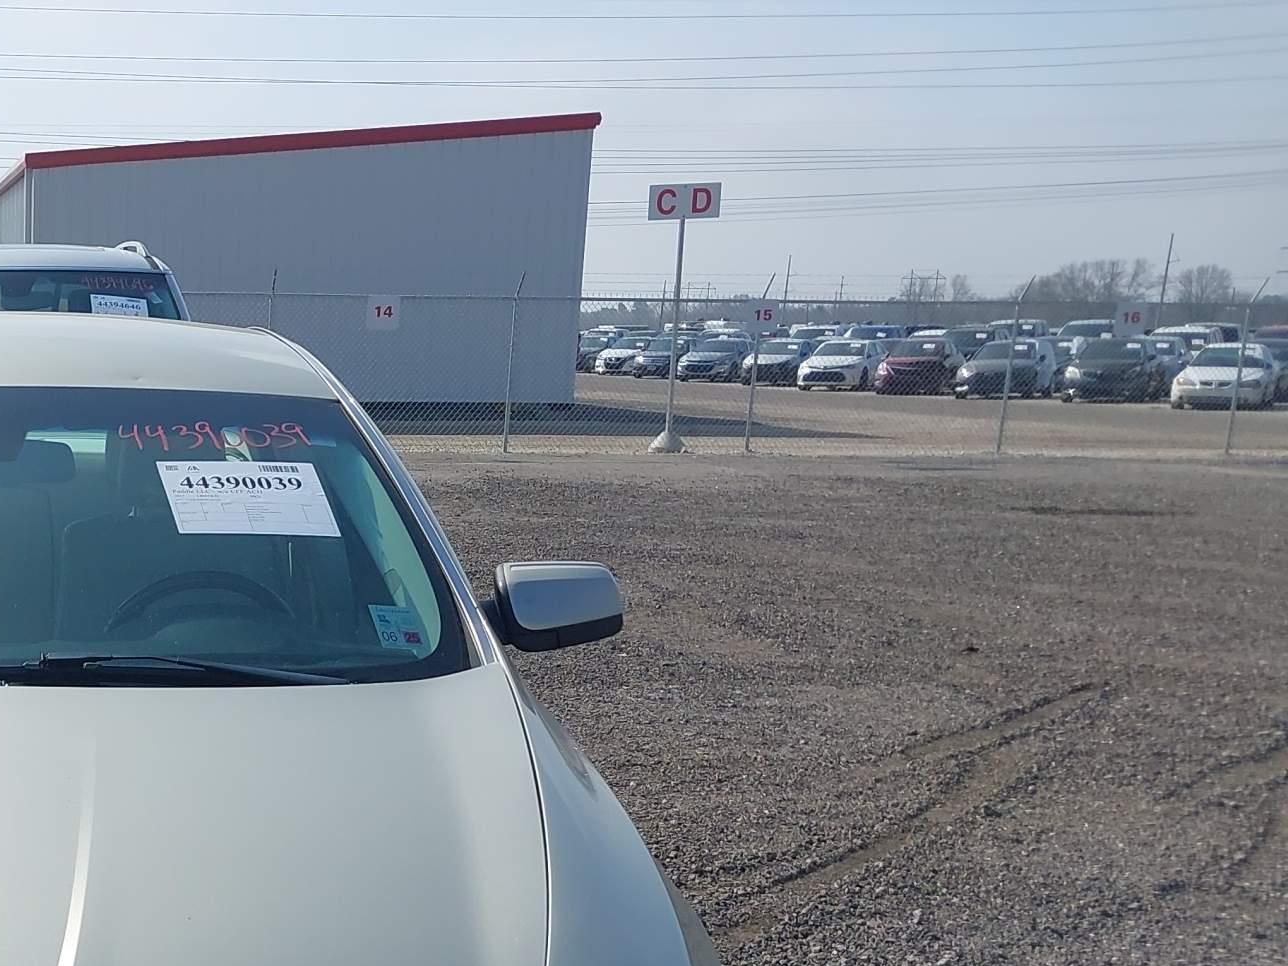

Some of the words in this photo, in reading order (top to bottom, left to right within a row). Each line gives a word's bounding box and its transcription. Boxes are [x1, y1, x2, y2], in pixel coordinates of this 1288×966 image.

[657, 189, 677, 215] C
[691, 188, 712, 213] D
[375, 305, 393, 318] 14
[754, 309, 772, 321] 15
[1122, 311, 1140, 324] 16
[119, 421, 311, 451] 44390039
[180, 476, 302, 491] 44390039
[382, 631, 398, 642] 06
